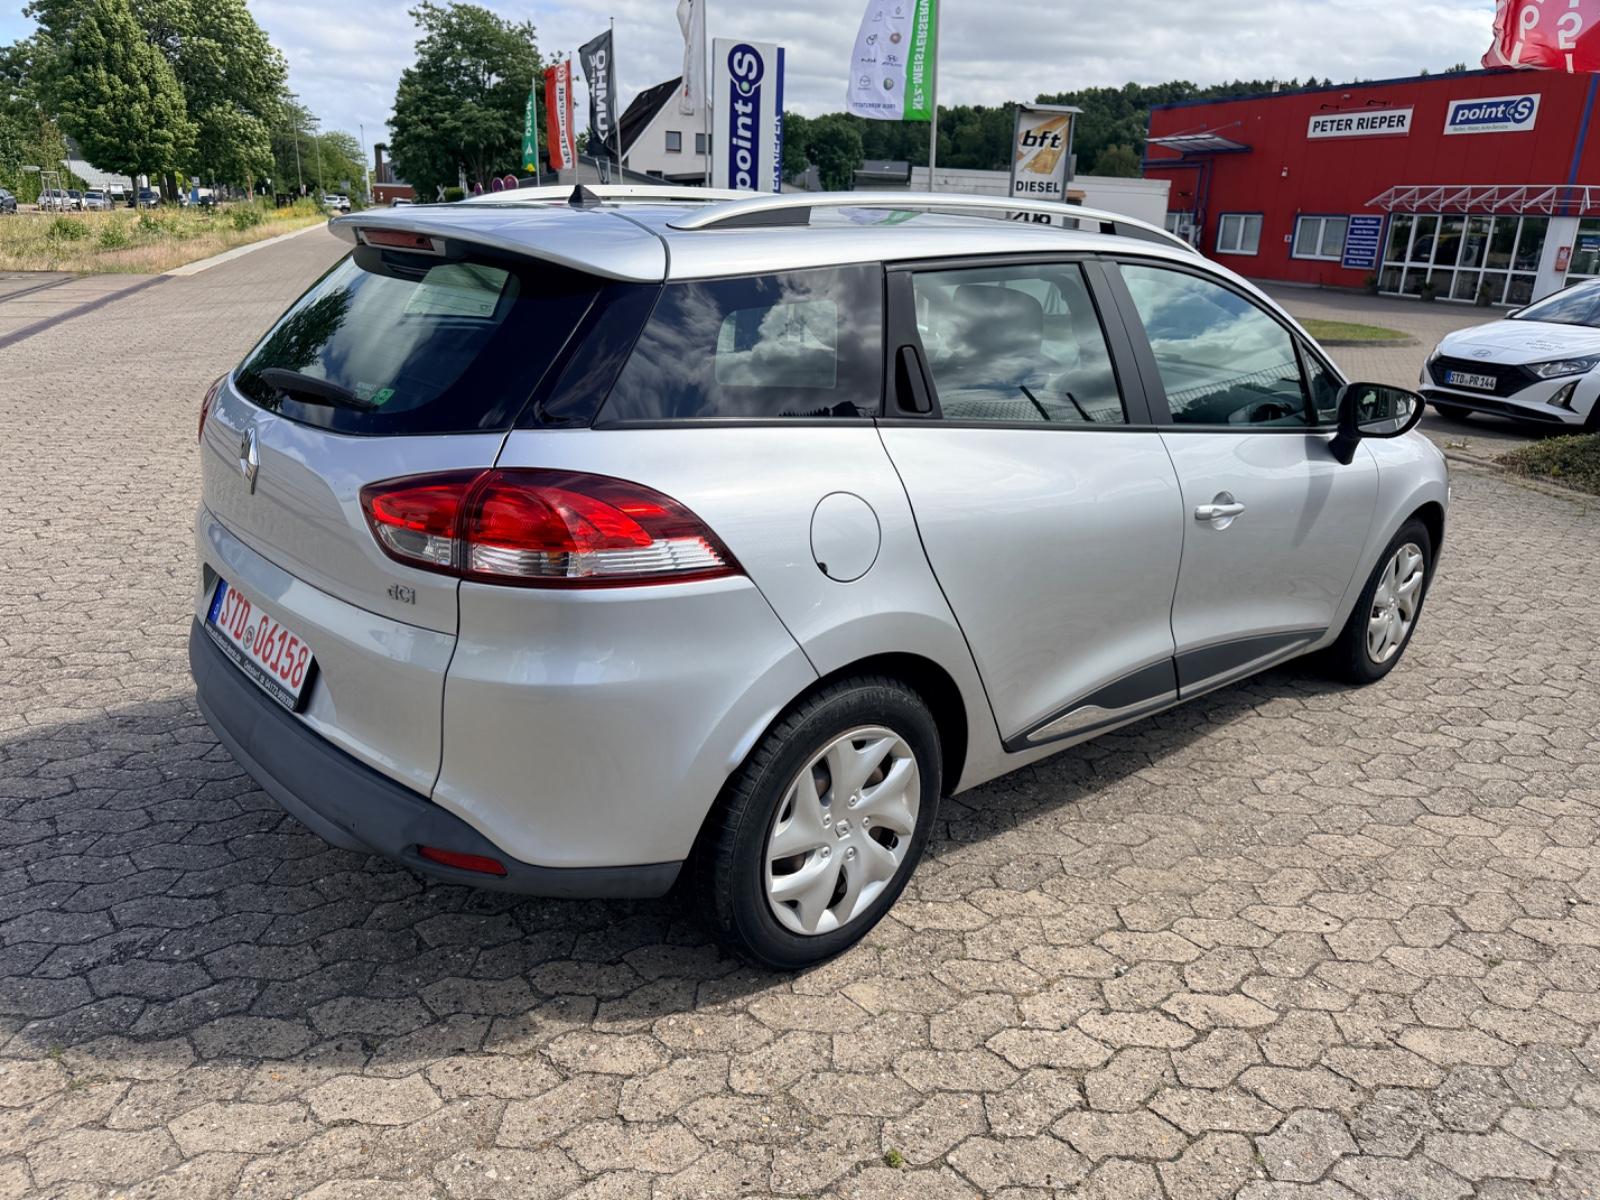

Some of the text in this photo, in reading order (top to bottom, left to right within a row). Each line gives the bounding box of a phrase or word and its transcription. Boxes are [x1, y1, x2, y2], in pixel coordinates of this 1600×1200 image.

[1456, 105, 1504, 123] point
[1312, 114, 1406, 133] PETER RIEPER
[731, 99, 753, 190] point
[1022, 130, 1061, 148] bft
[1015, 181, 1060, 193] DIESEL
[220, 588, 252, 641] STD
[252, 615, 309, 689] 06158
